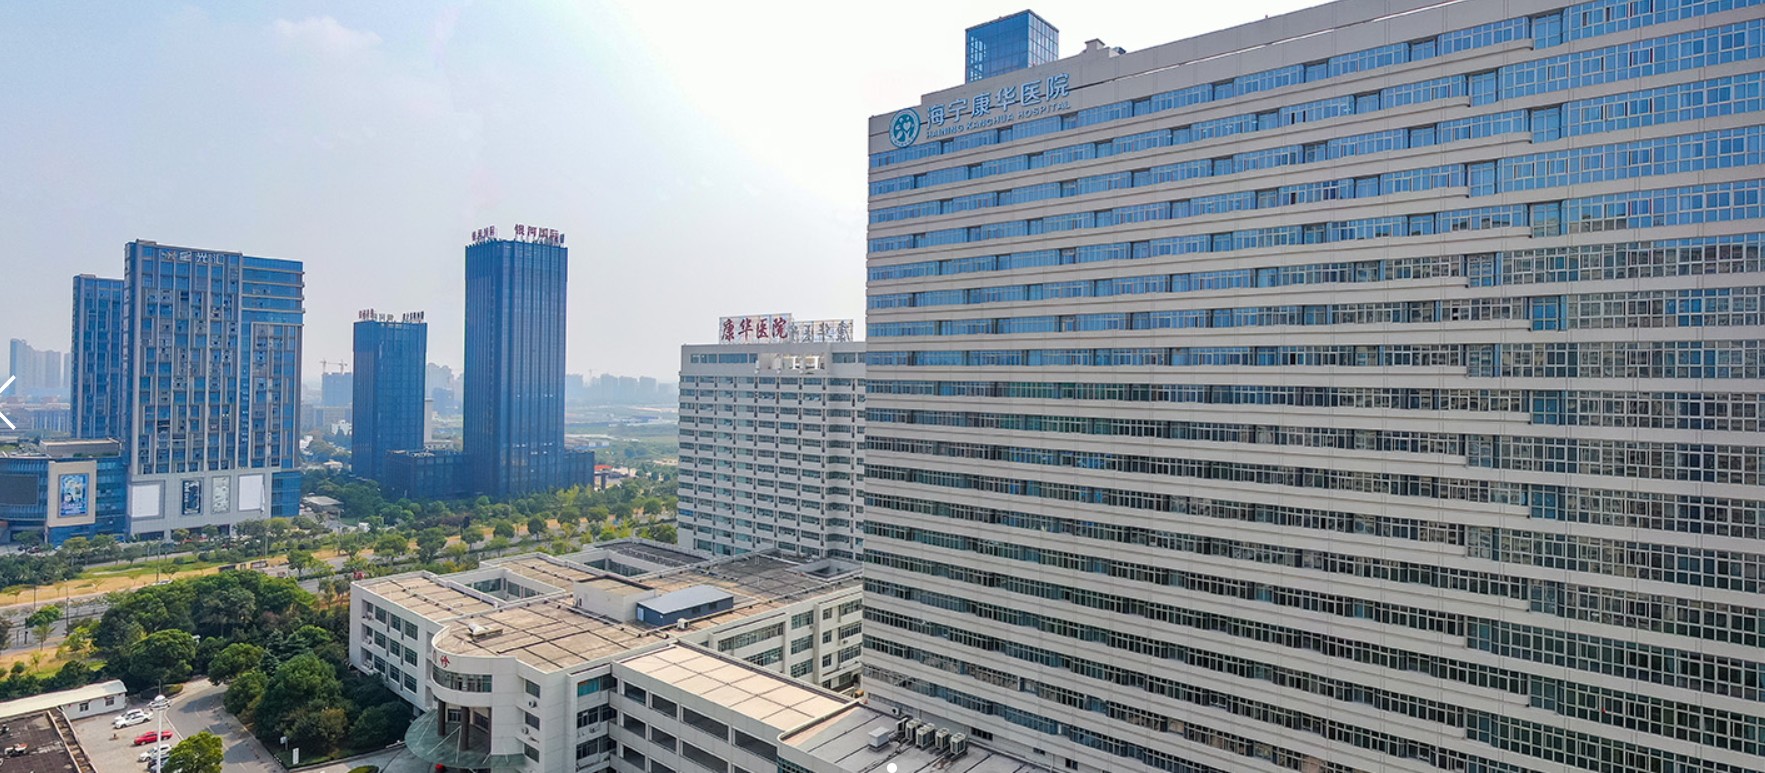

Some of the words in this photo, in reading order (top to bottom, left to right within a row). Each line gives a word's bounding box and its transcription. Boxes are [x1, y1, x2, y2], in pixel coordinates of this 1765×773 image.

[926, 73, 1070, 129] 海宁康华医院
[926, 125, 964, 139] HAINING
[966, 114, 1014, 131] KANGHUA
[1018, 101, 1071, 119] HOSPITAL
[721, 317, 788, 341] 康华医院
